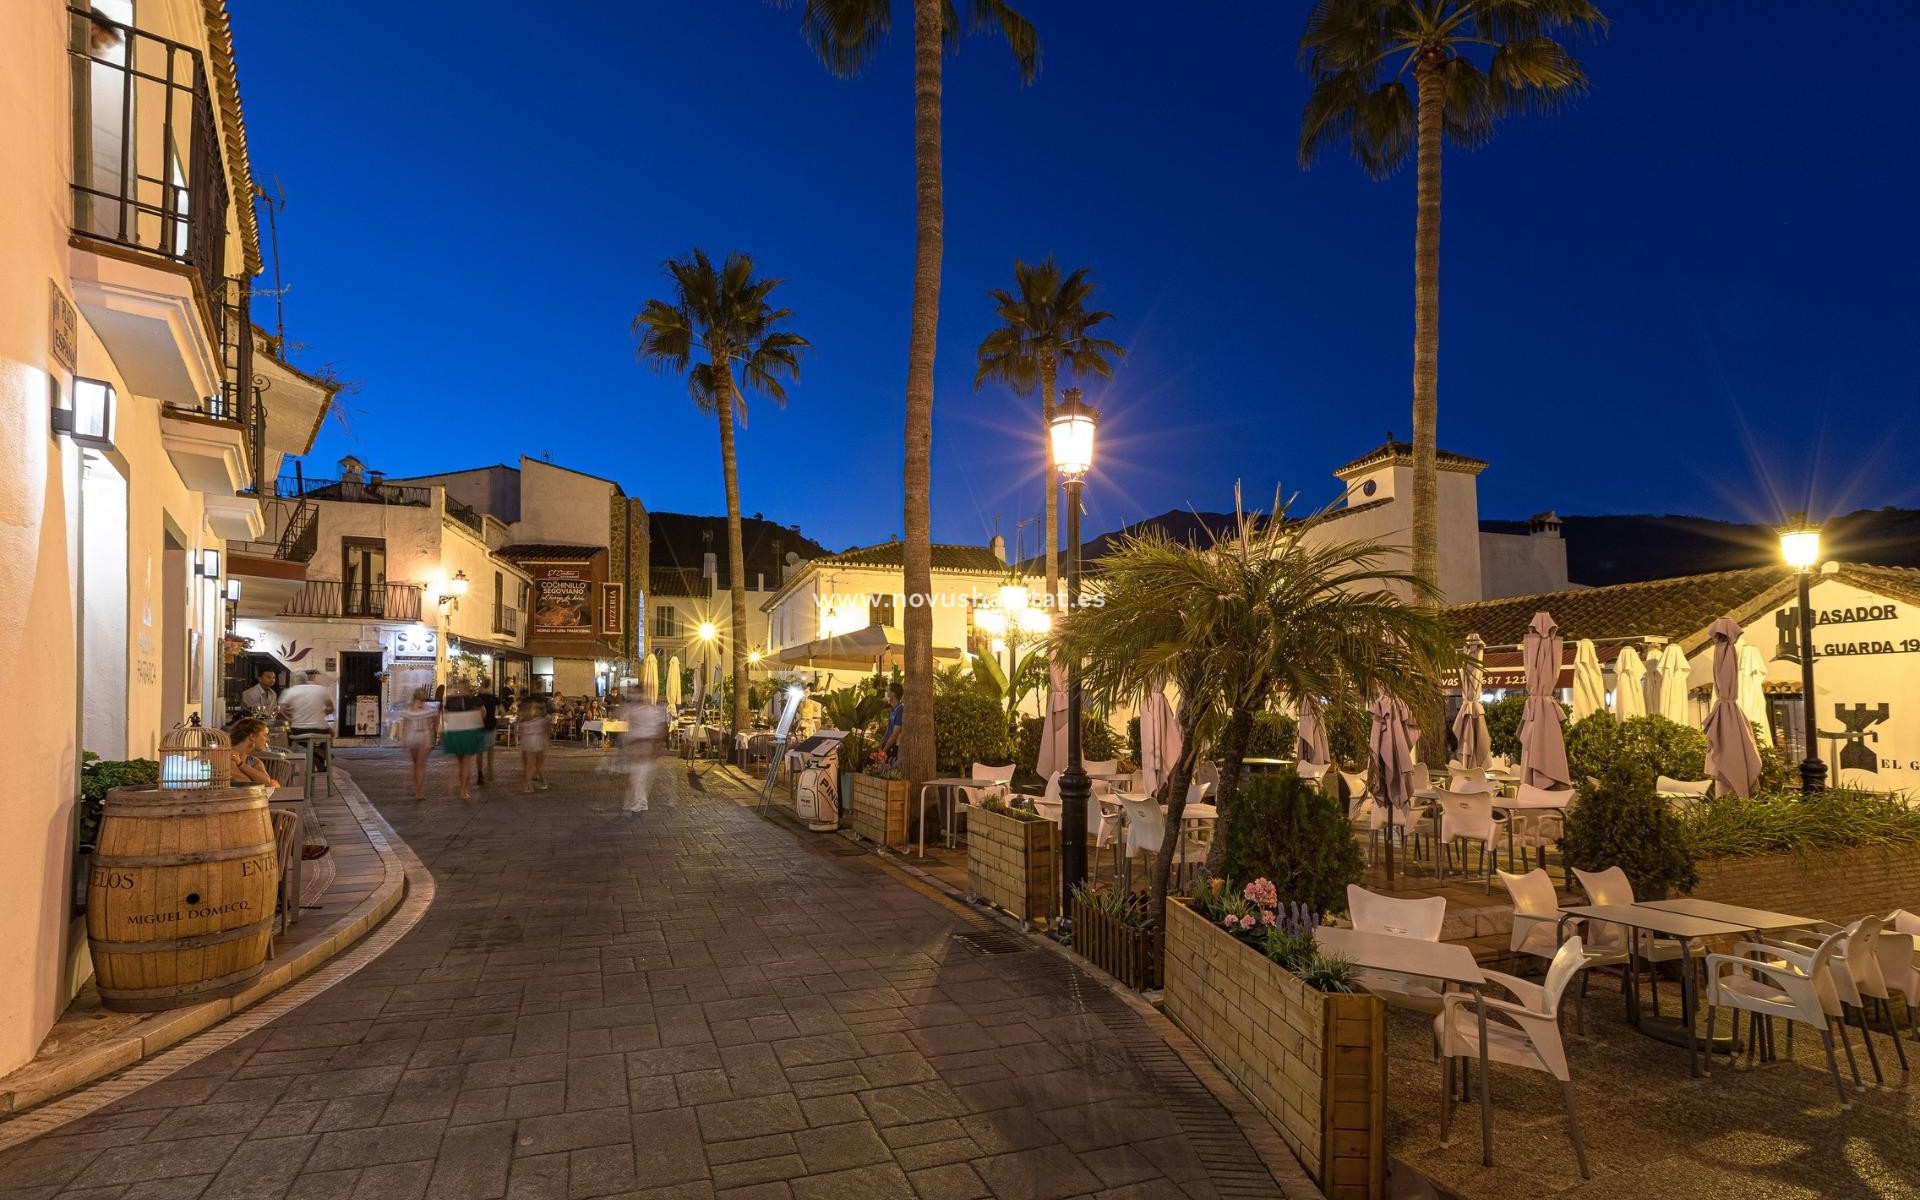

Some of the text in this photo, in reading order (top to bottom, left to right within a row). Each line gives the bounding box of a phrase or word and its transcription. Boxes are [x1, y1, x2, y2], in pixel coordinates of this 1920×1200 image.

[1819, 605, 1898, 625] ASADOR
[1824, 641, 1894, 656] GUARDA
[1899, 639, 1920, 653] 19
[1441, 678, 1459, 687] vas
[1881, 759, 1902, 770] EL
[91, 870, 134, 889] ELOS
[128, 900, 257, 925] MIGUEL DOMECQ
